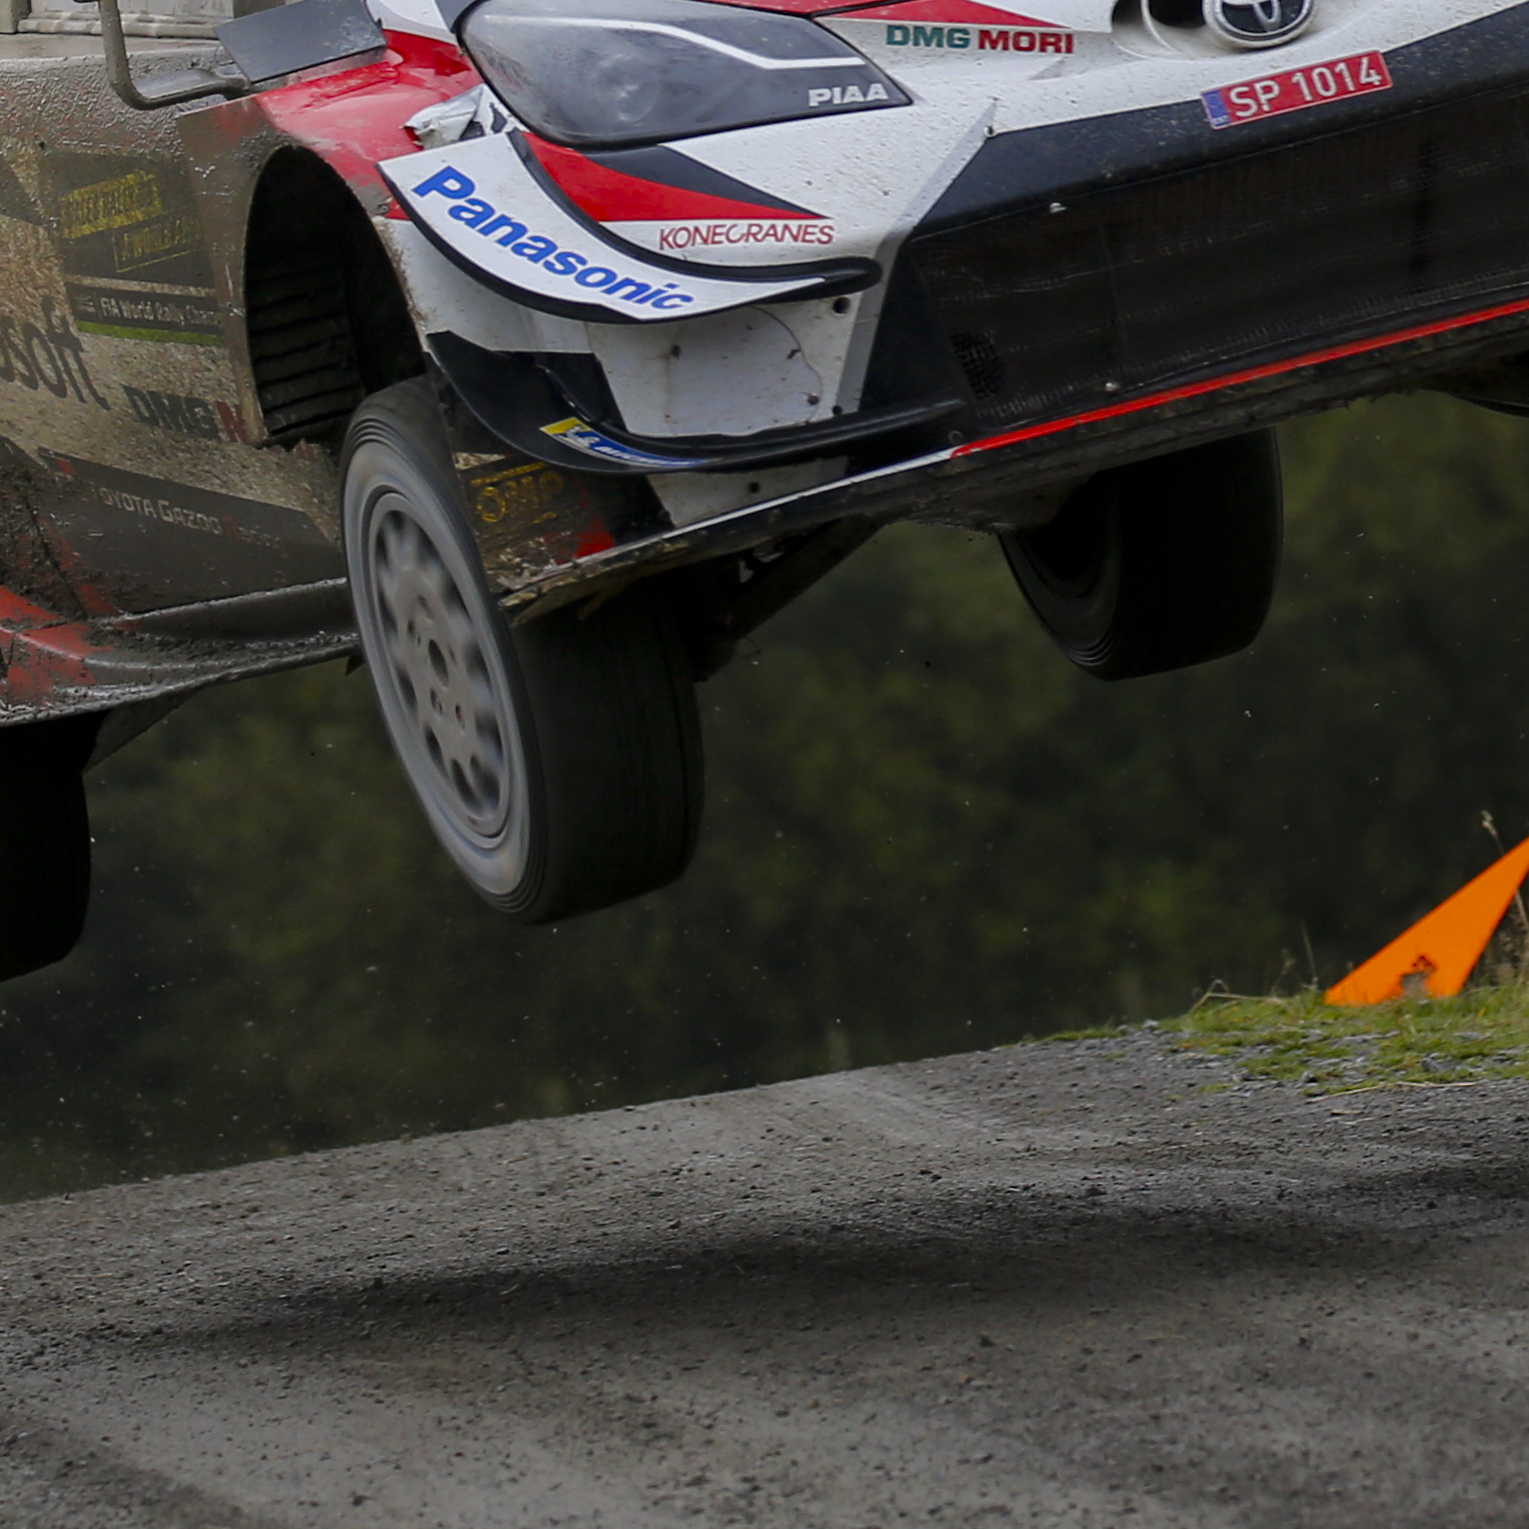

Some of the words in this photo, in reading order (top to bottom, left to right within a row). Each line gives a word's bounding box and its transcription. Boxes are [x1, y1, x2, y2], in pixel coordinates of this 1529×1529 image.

[886, 25, 970, 49] DMG
[978, 30, 1074, 54] MORI
[808, 83, 889, 107] PIAA
[1229, 80, 1281, 118] SP
[1290, 56, 1383, 103] 1014
[412, 165, 695, 310] Panasonic
[659, 224, 835, 251] KONECRANES
[122, 384, 220, 441] DMG
